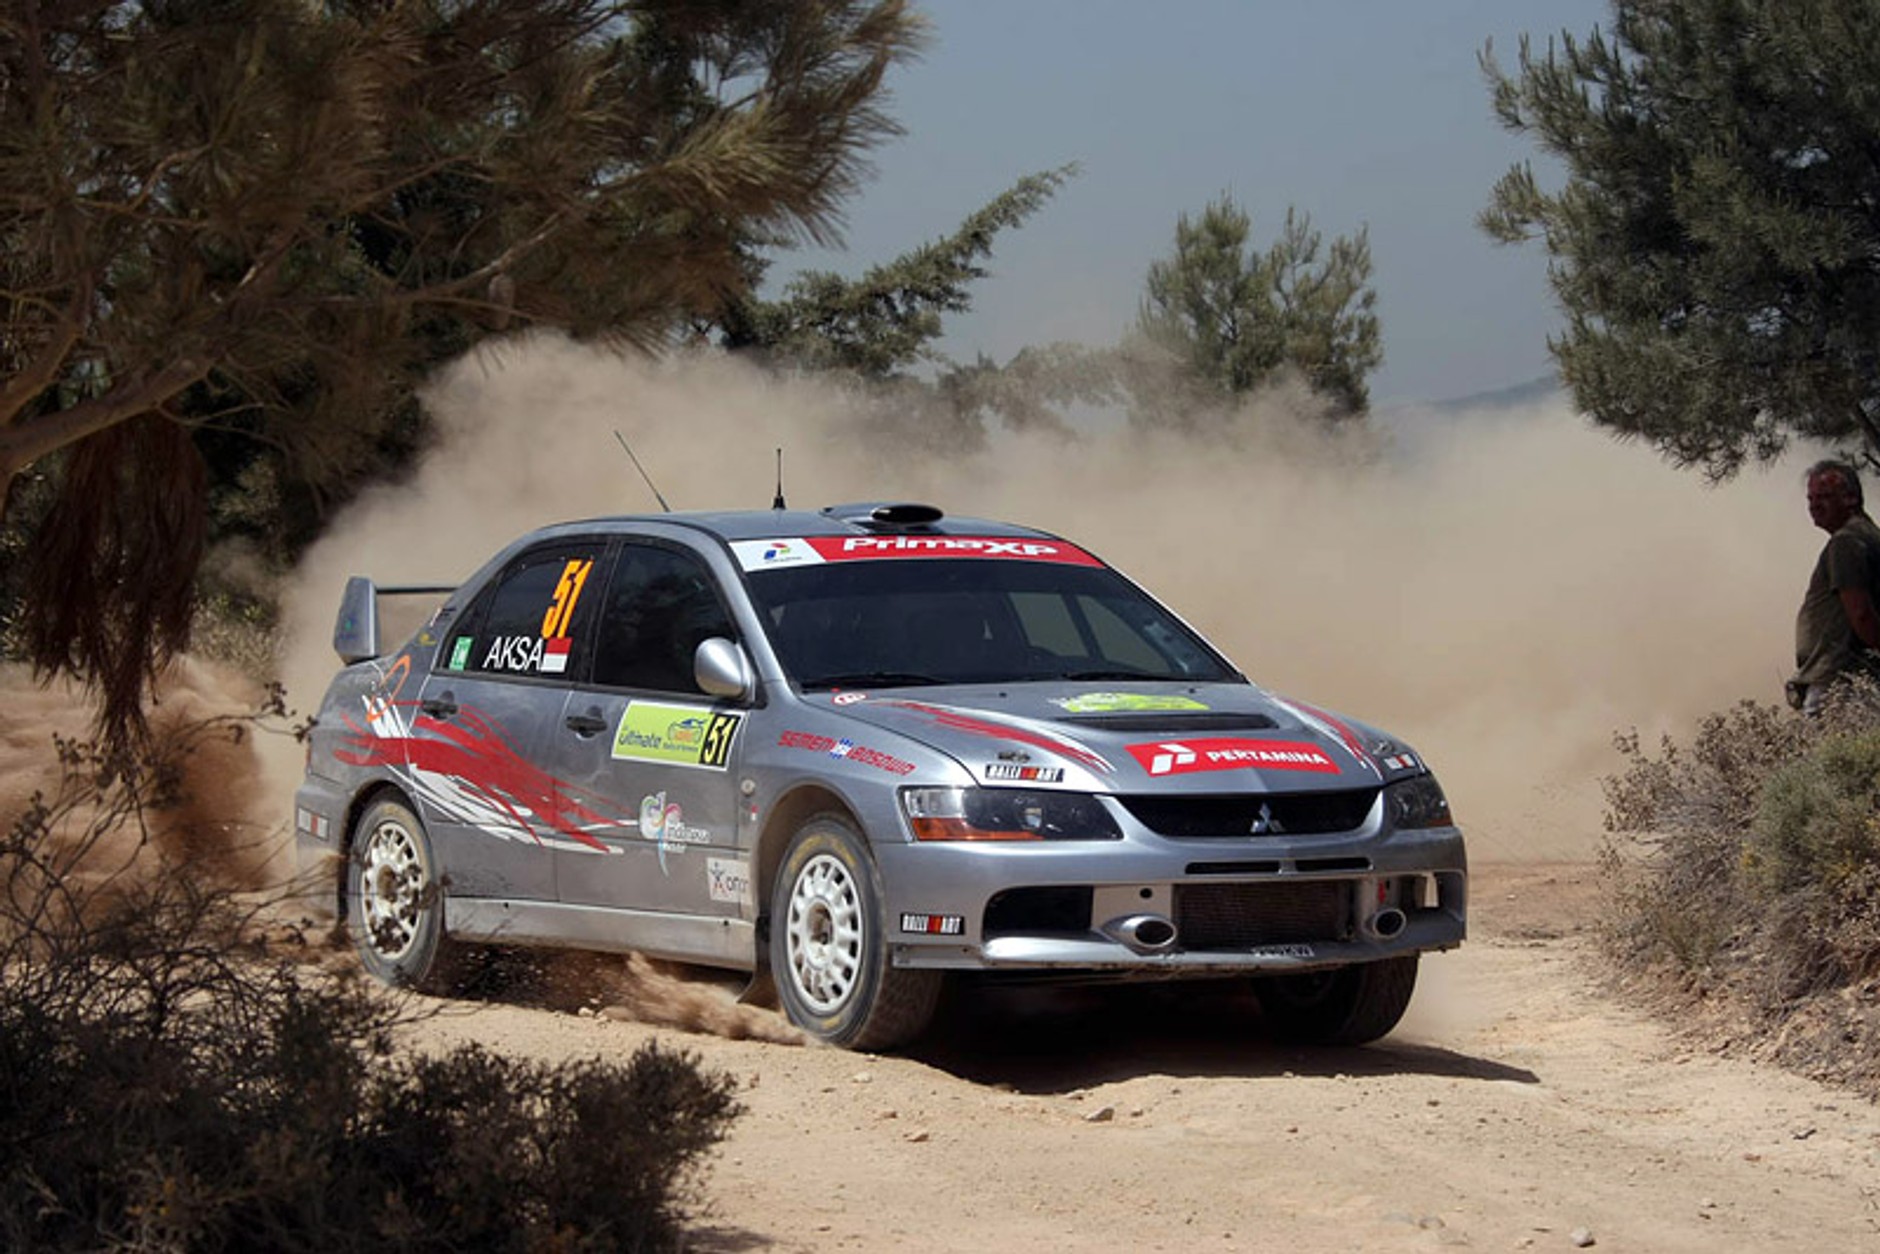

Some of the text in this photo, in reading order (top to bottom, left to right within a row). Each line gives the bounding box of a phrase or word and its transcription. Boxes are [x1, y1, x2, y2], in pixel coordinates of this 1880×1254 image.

[541, 560, 594, 640] 51
[482, 636, 544, 671] AKSA
[704, 715, 737, 765] 51
[1206, 749, 1329, 766] PERTAMINA
